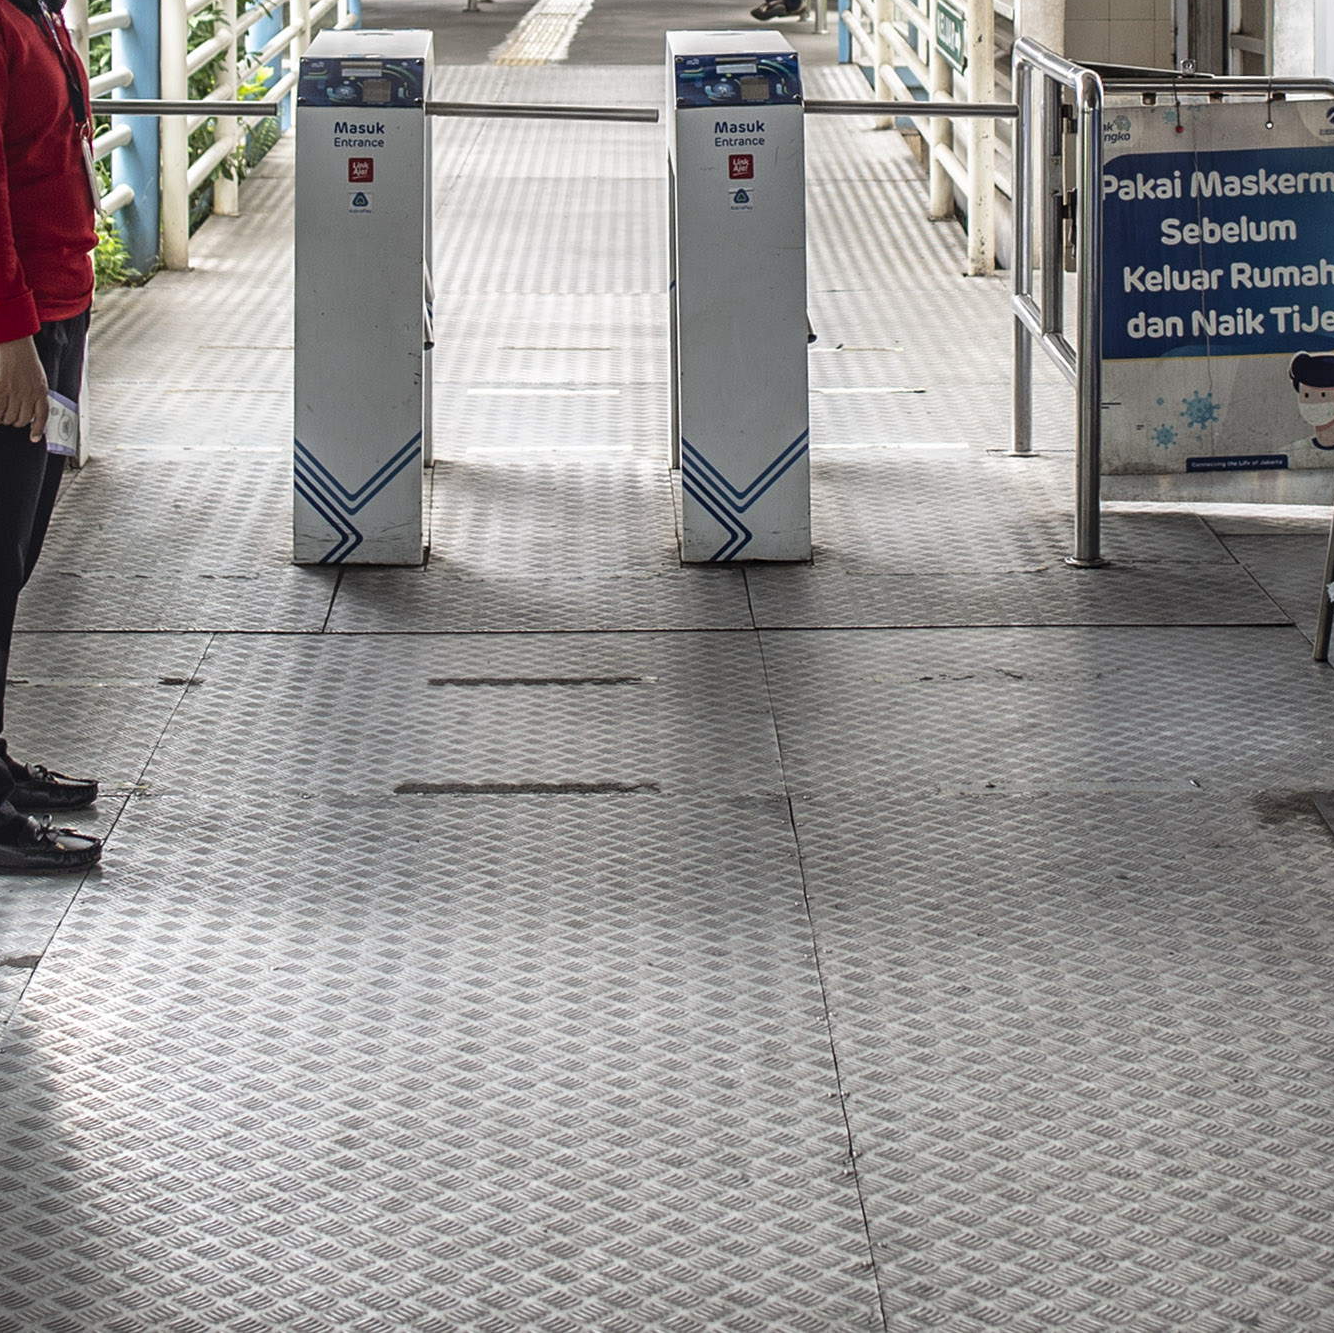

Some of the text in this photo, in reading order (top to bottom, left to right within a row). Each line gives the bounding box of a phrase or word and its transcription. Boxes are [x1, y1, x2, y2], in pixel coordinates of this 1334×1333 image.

[334, 122, 385, 134] Masuk
[714, 120, 765, 133] Masuk
[334, 138, 385, 147] Entrance
[715, 137, 765, 147] Entrance
[733, 158, 749, 166] Link
[1102, 169, 1182, 201] Pakai
[1161, 216, 1297, 245] Sebelum
[1123, 265, 1224, 293] Keluar
[1127, 311, 1184, 338] dan
[1191, 307, 1265, 337] Naik
